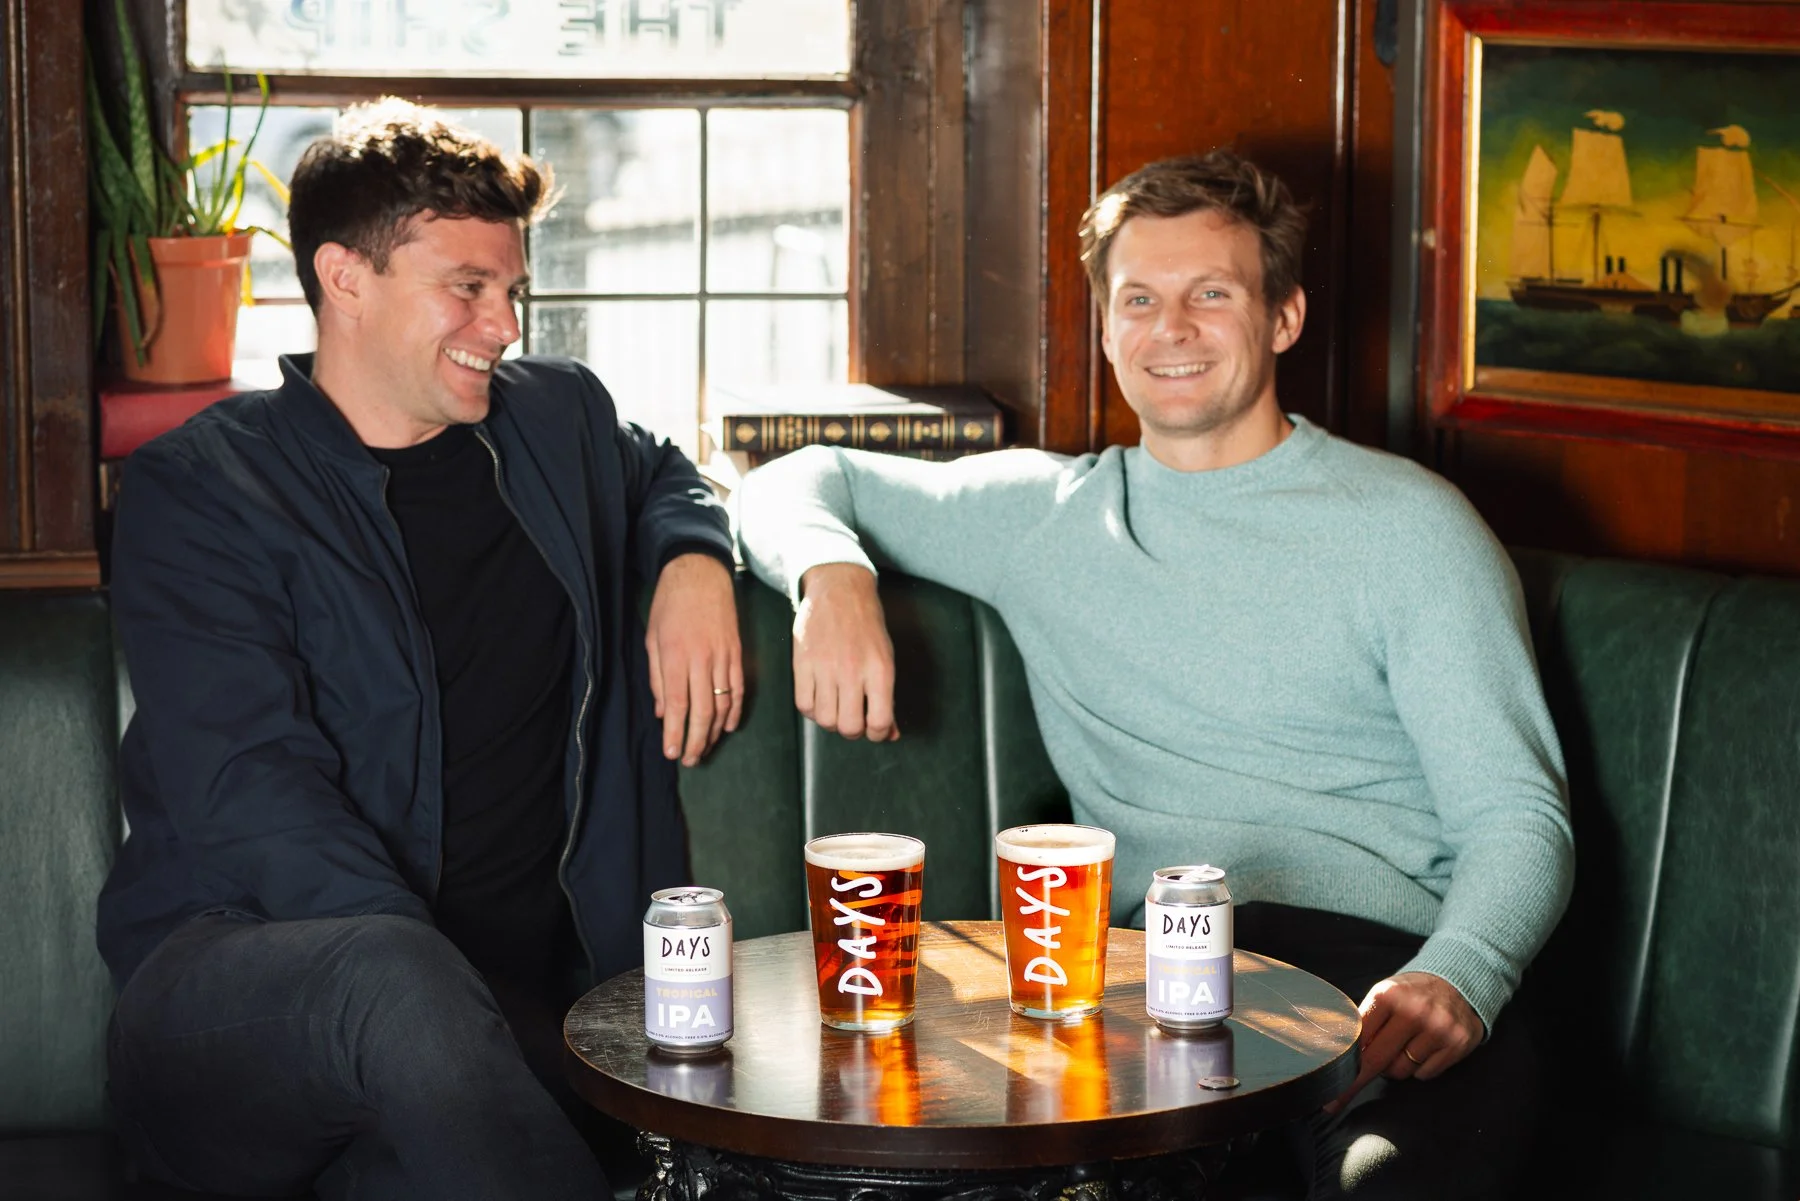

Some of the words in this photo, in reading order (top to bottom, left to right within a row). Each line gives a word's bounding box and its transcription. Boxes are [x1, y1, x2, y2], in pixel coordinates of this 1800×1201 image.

[829, 876, 885, 997] DAYS
[1015, 866, 1070, 987] DAYS
[1163, 913, 1211, 937] DAYS
[661, 936, 710, 960] DAYS
[656, 987, 719, 999] TROPICAL
[1158, 979, 1215, 1006] IPA
[658, 1003, 716, 1028] IPA
